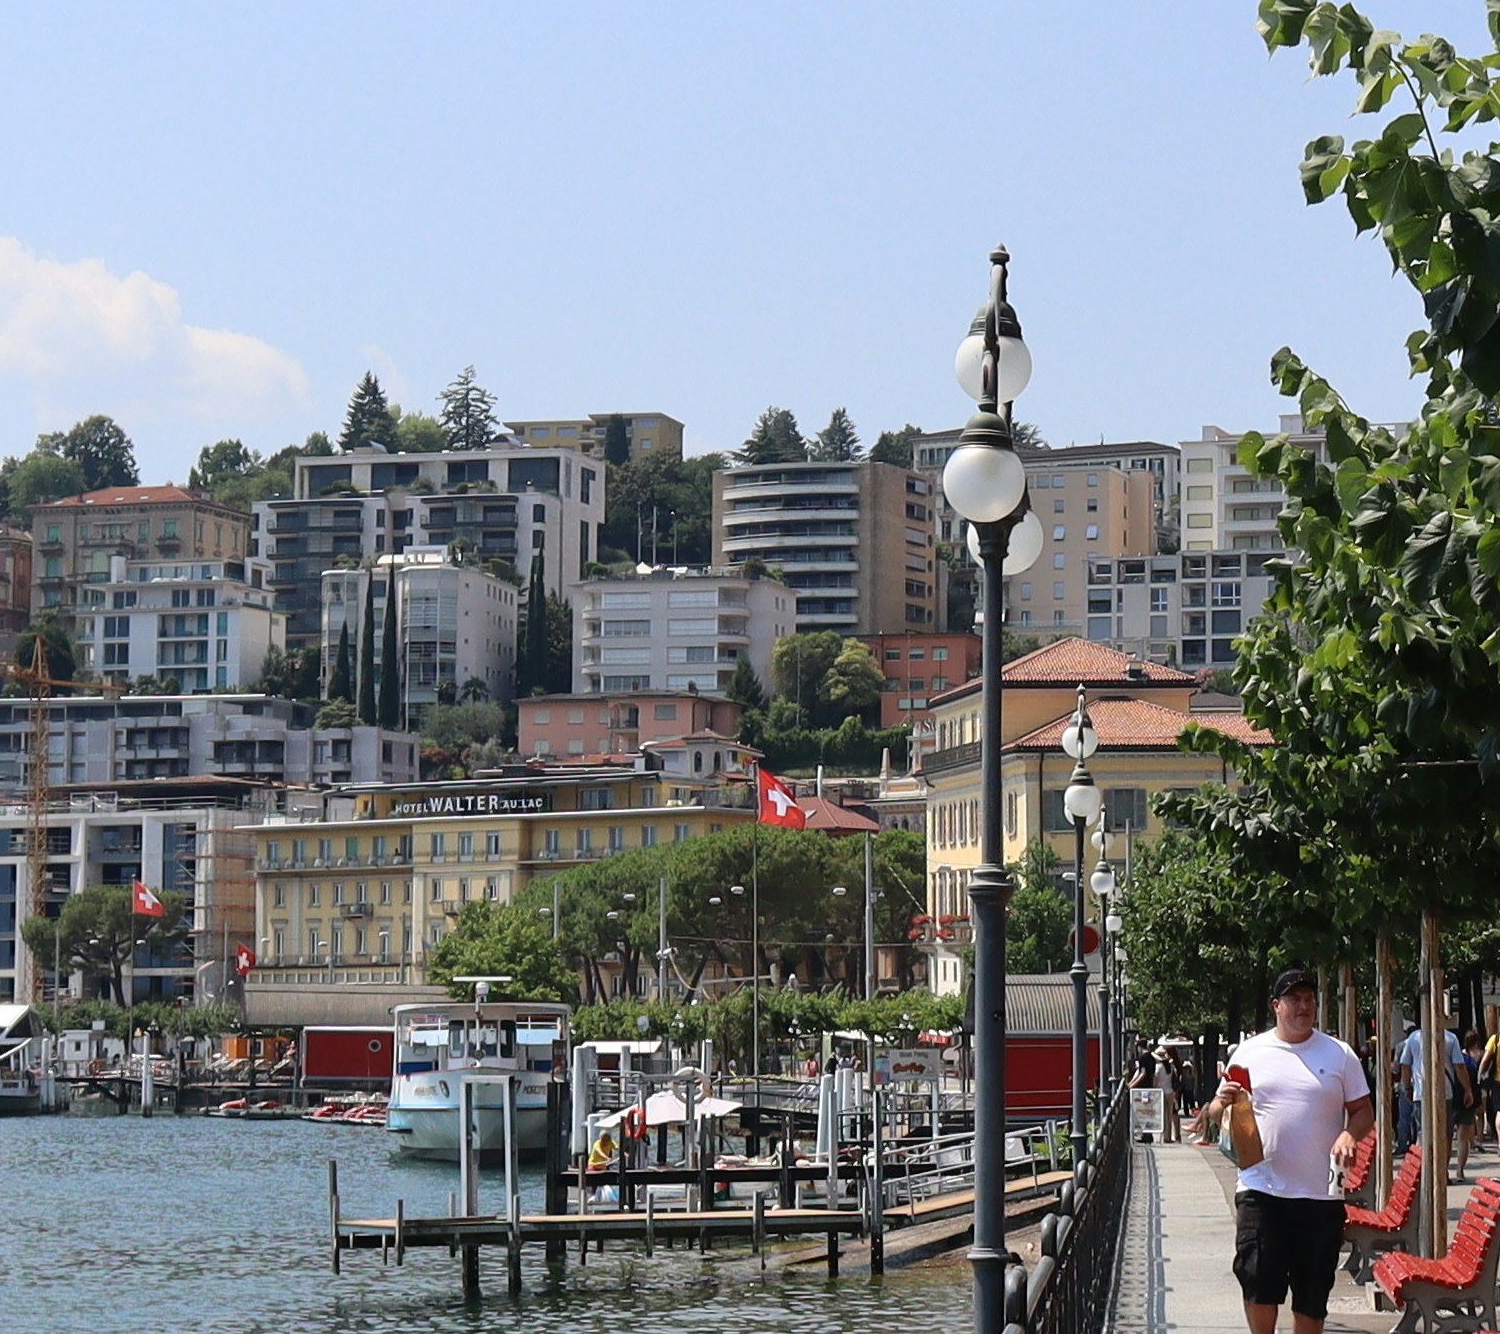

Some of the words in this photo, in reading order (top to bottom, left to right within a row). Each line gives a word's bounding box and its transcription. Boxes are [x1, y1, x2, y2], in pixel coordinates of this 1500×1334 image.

[395, 802, 429, 814] HOTEL
[430, 794, 499, 812] WALTER
[503, 799, 518, 809] AU
[521, 797, 544, 809] LAC
